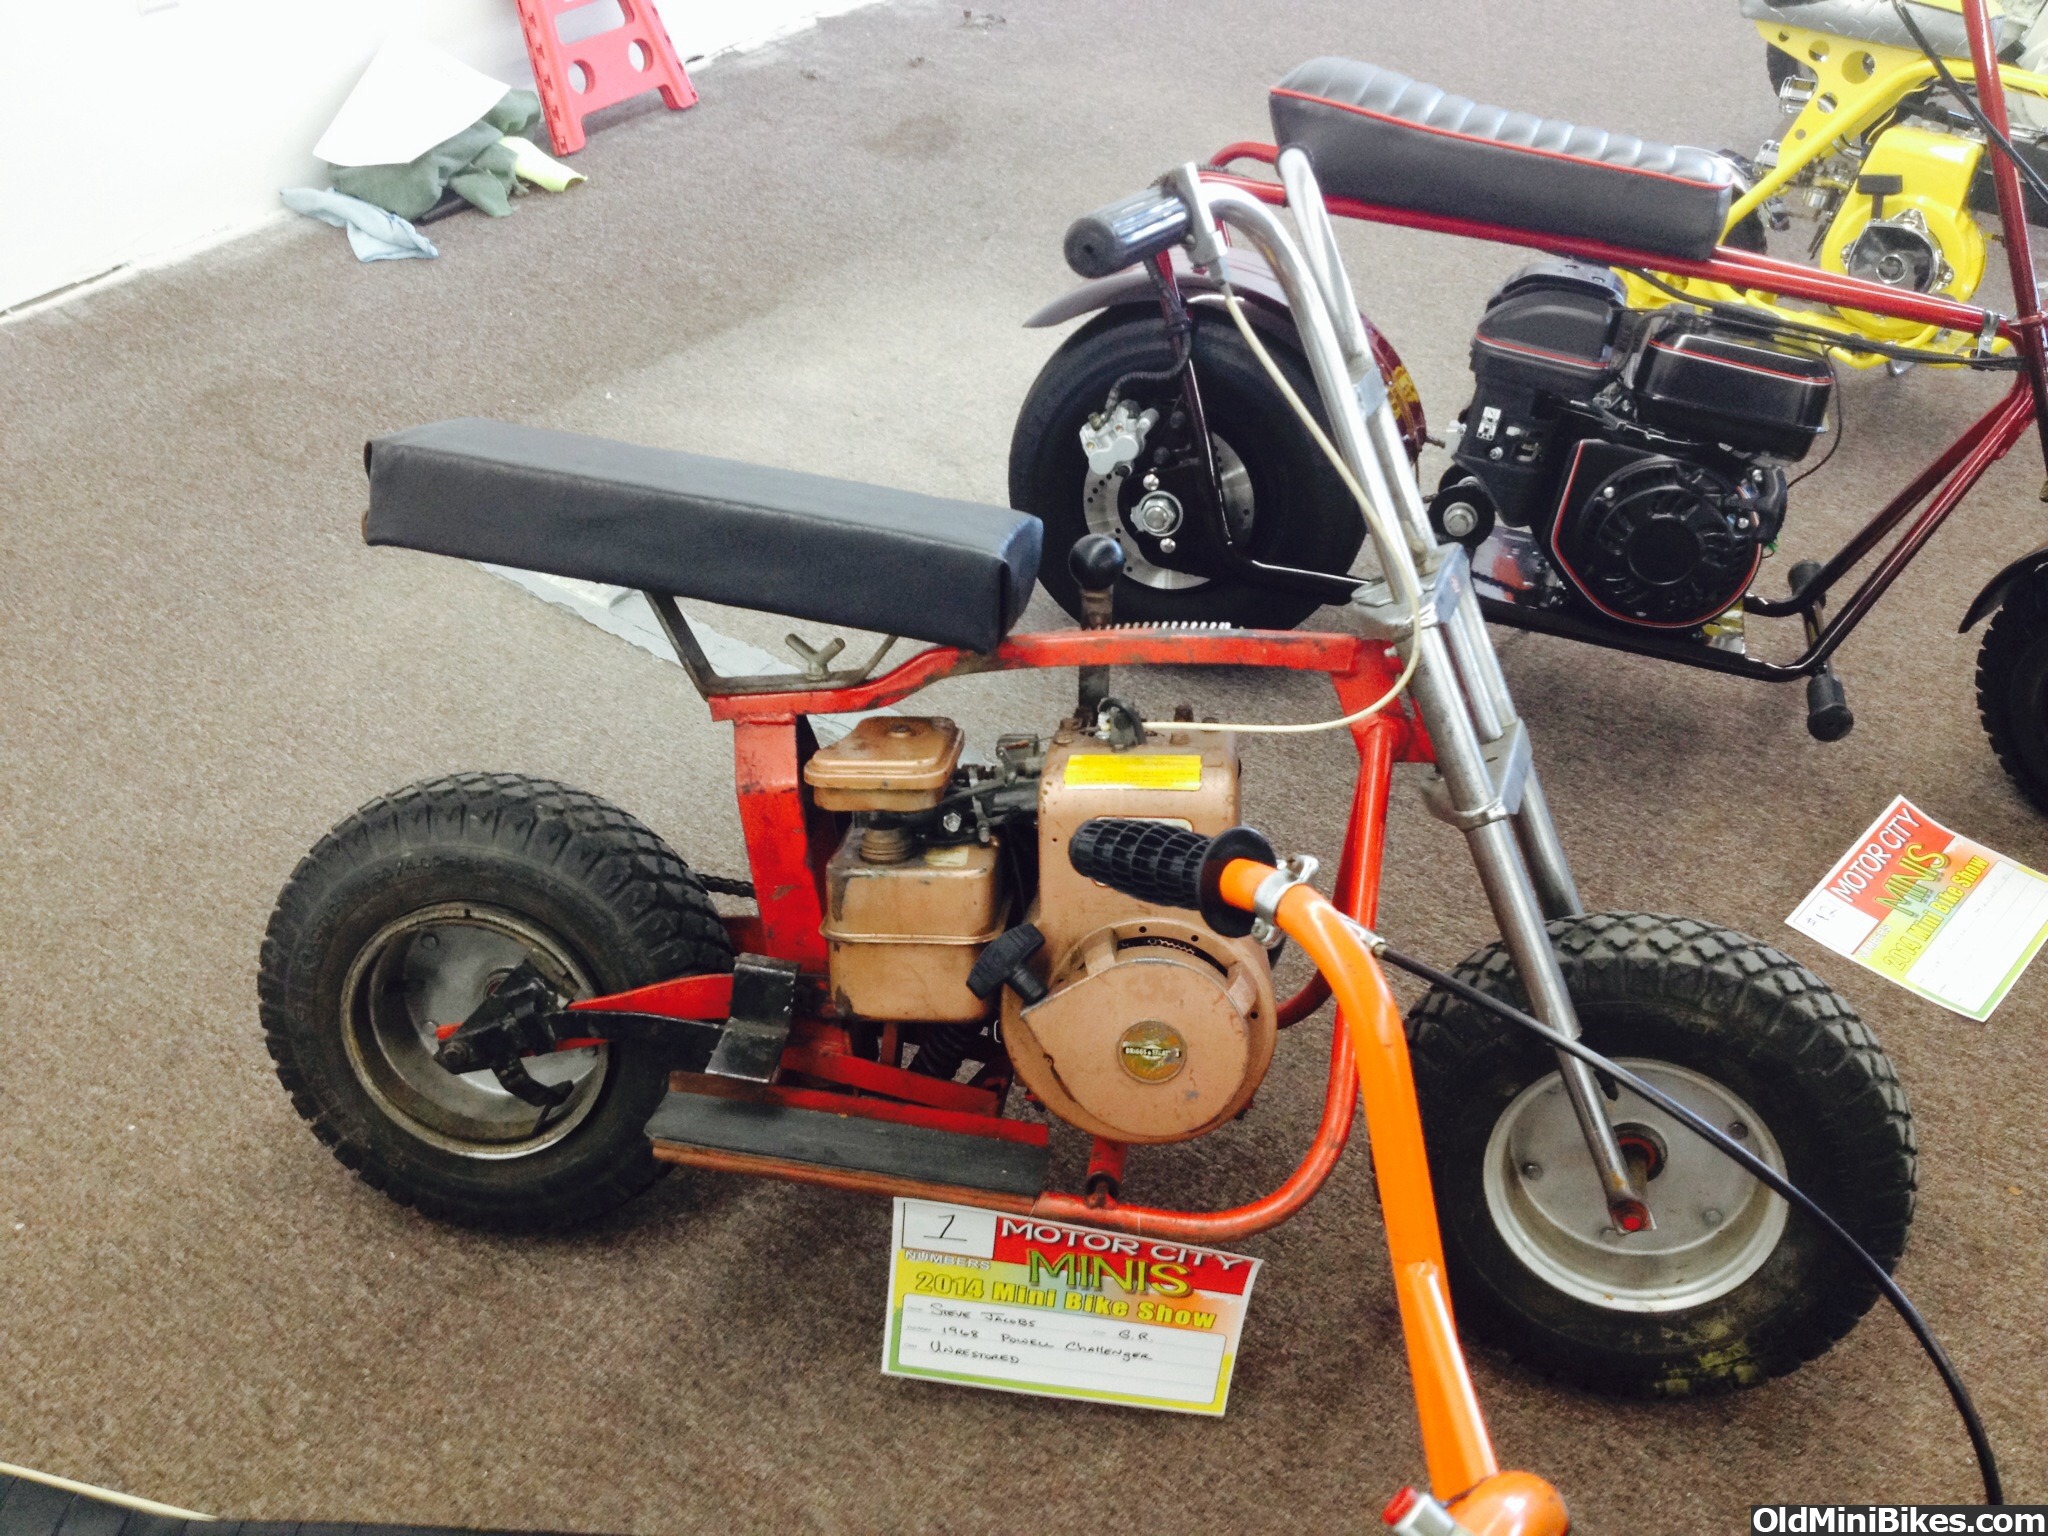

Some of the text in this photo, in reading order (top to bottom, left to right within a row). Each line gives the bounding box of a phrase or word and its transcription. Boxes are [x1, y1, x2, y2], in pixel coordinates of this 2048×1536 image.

[1830, 807, 1921, 903] MOTOR CITY
[1875, 843, 1949, 918] MINIS
[1883, 936, 1922, 971] 2014
[1907, 910, 1945, 942] Mini
[1930, 885, 1966, 915] Bike
[1951, 855, 1990, 888] Show
[923, 1214, 967, 1242] 1
[1001, 1219, 1246, 1271] MOTOR CITY
[905, 1250, 991, 1271] NUMBERS
[1028, 1249, 1192, 1298] MINIS
[915, 1271, 1217, 1329] 2014 Mini Bike Show
[942, 1326, 979, 1339] 1968
